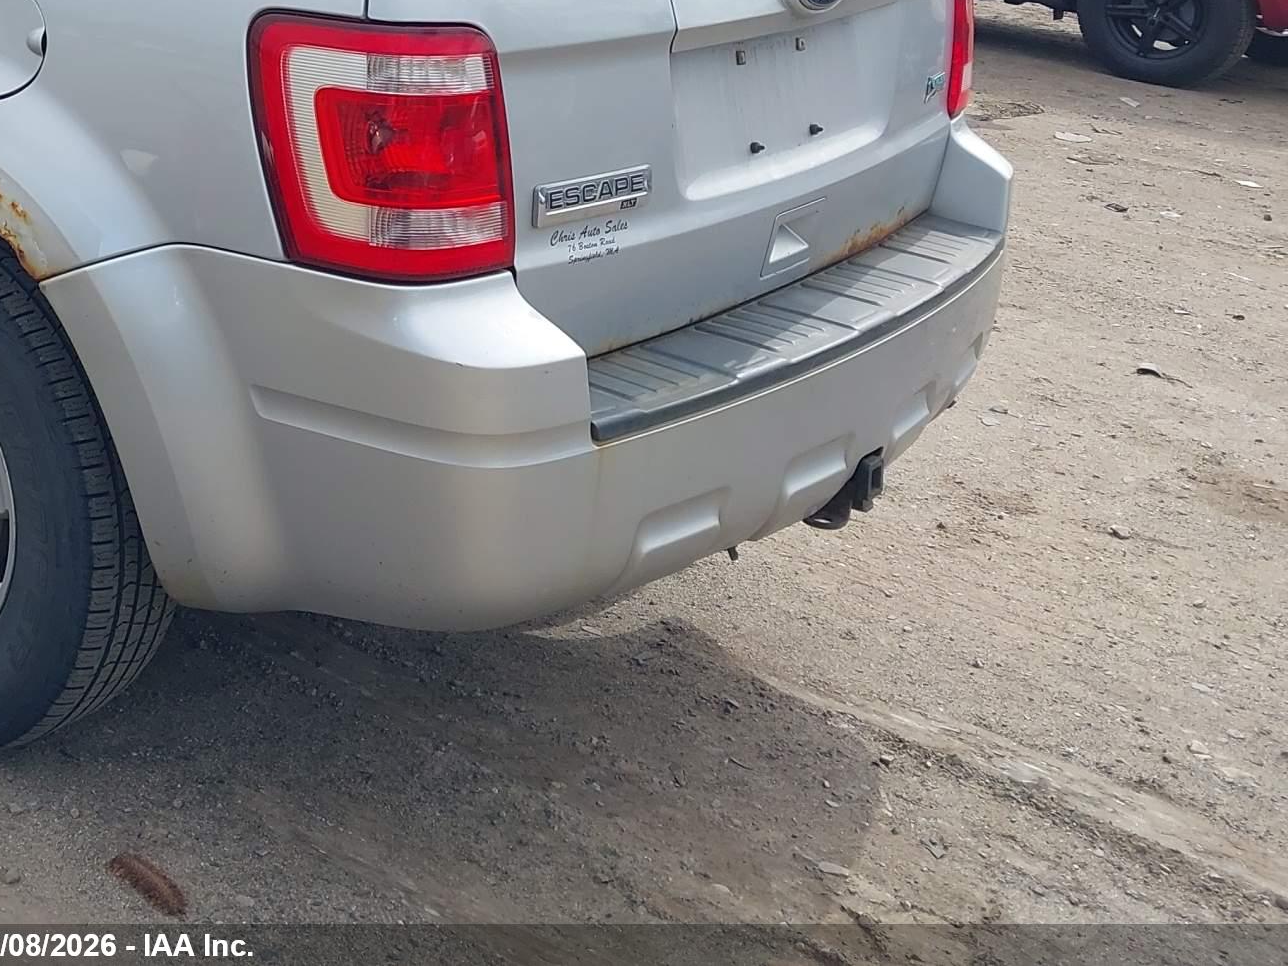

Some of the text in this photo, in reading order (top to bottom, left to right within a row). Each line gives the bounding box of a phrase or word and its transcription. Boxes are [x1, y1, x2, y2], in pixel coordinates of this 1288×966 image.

[549, 174, 644, 209] ESCAPE
[550, 219, 628, 247] Chris Auto Sales
[599, 237, 616, 246] Road
